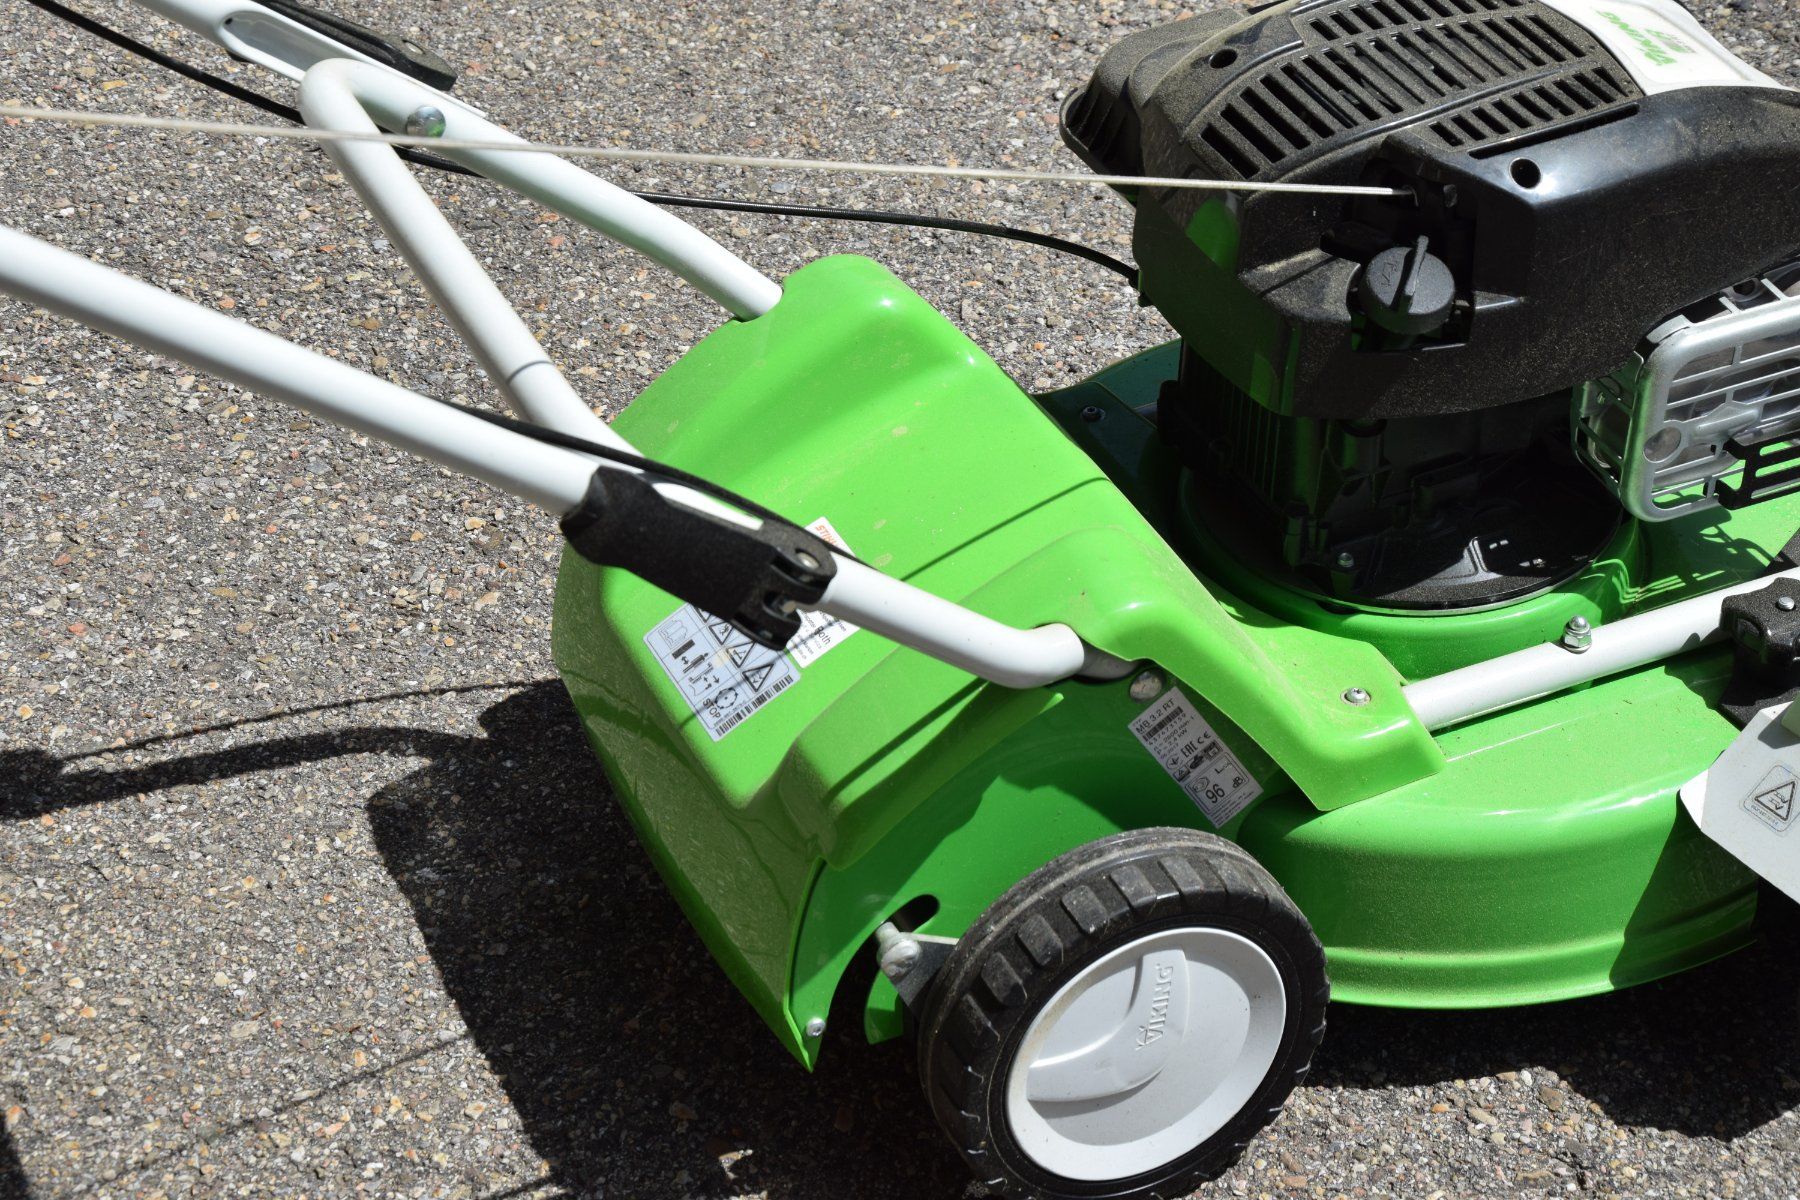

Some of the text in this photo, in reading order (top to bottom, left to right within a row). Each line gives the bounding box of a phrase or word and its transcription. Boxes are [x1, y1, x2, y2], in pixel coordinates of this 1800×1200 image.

[815, 625, 831, 646] Roth
[703, 698, 721, 718] STOP
[1136, 720, 1150, 734] MB
[1162, 698, 1174, 711] RT
[1205, 776, 1244, 804] 96 dB
[1138, 965, 1174, 1048] VIKING
